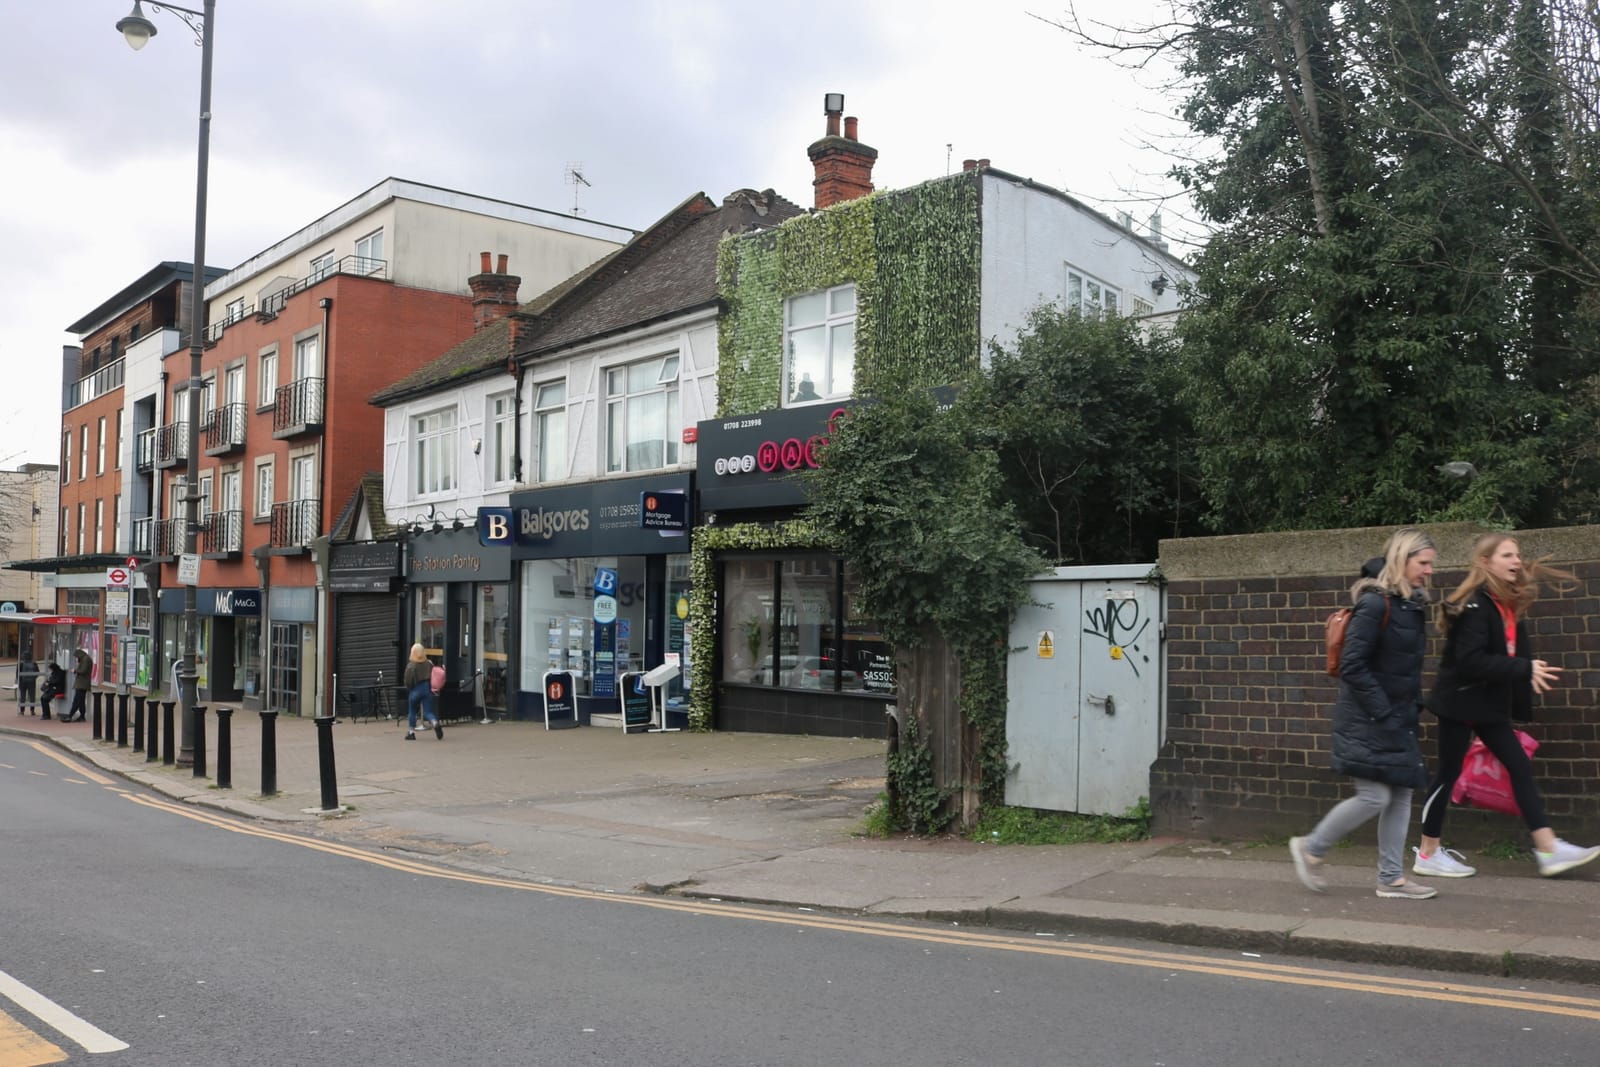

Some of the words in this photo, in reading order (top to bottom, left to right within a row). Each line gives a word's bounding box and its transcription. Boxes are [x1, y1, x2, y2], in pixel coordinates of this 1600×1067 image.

[723, 422, 739, 431] 01708
[740, 418, 762, 428] 223998
[715, 454, 755, 476] THE
[599, 506, 618, 518] 01708
[645, 511, 671, 520] Mortgage
[487, 514, 508, 539] B
[520, 506, 589, 540] Balgores
[645, 518, 664, 526] Advice
[664, 519, 683, 527] Bureau
[128, 558, 137, 568] A
[409, 555, 422, 571] The
[423, 554, 451, 570] Station
[453, 553, 480, 572] Pantry
[597, 570, 614, 590] B
